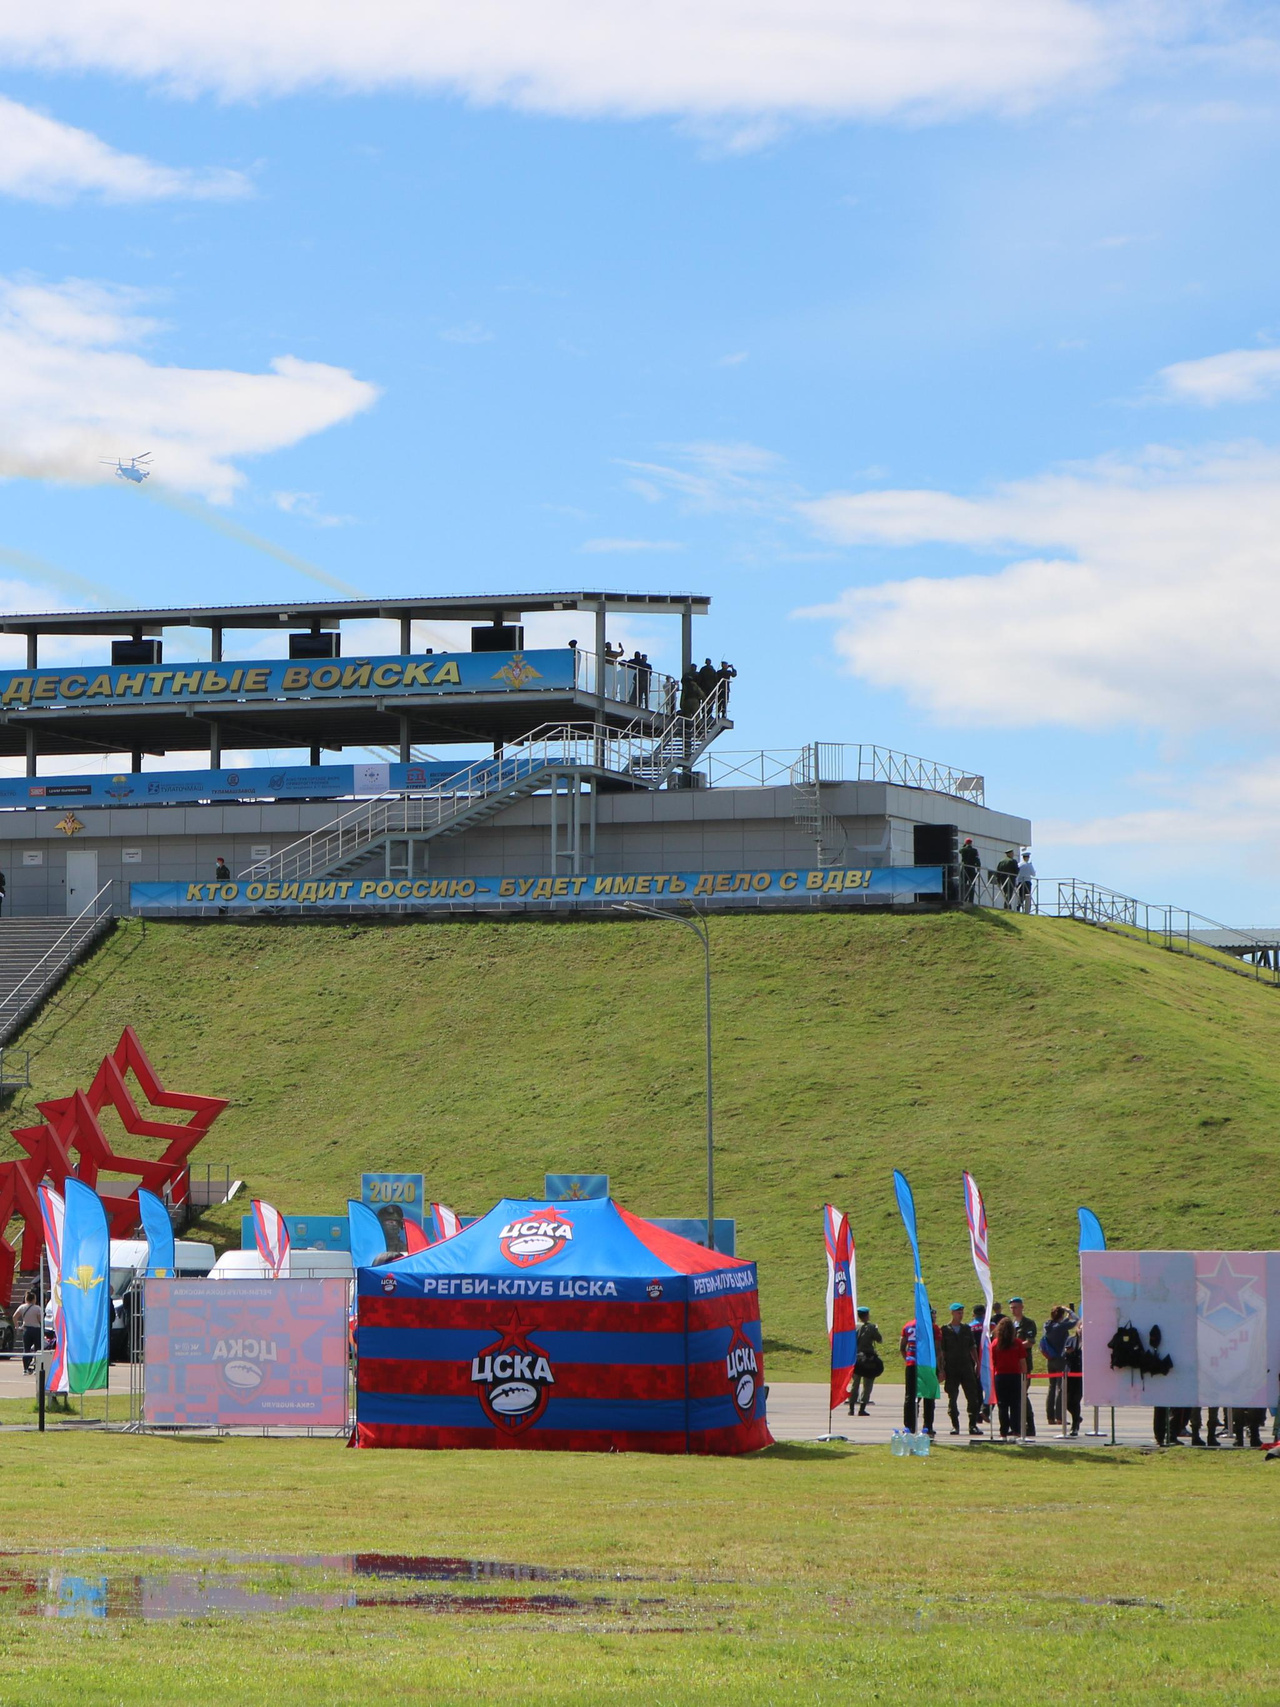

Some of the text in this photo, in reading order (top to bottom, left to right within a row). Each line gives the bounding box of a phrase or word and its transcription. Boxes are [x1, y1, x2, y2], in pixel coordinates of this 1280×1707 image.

[282, 659, 462, 692] ВОЙСКА
[186, 882, 239, 902] КТО
[246, 881, 354, 903] ОБИДИТ
[499, 876, 587, 900] БУДЕТ
[593, 874, 687, 895] ИМЕТЬ
[693, 872, 772, 896] ДЕЛО
[778, 871, 798, 891] С
[806, 869, 873, 893] ВДВ!
[369, 1181, 416, 1204] 2020
[498, 1220, 574, 1241] ЦСКА
[380, 1277, 398, 1286] ЦСКА
[423, 1278, 618, 1297] РЕГБИ-КЛУБ ЦСКА
[646, 1284, 664, 1293] ЦСКА
[693, 1270, 754, 1296] РЕГБИ-КЛУБ ЦСКА
[470, 1353, 555, 1384] ЦСКА
[726, 1346, 758, 1380] ЦСКА
